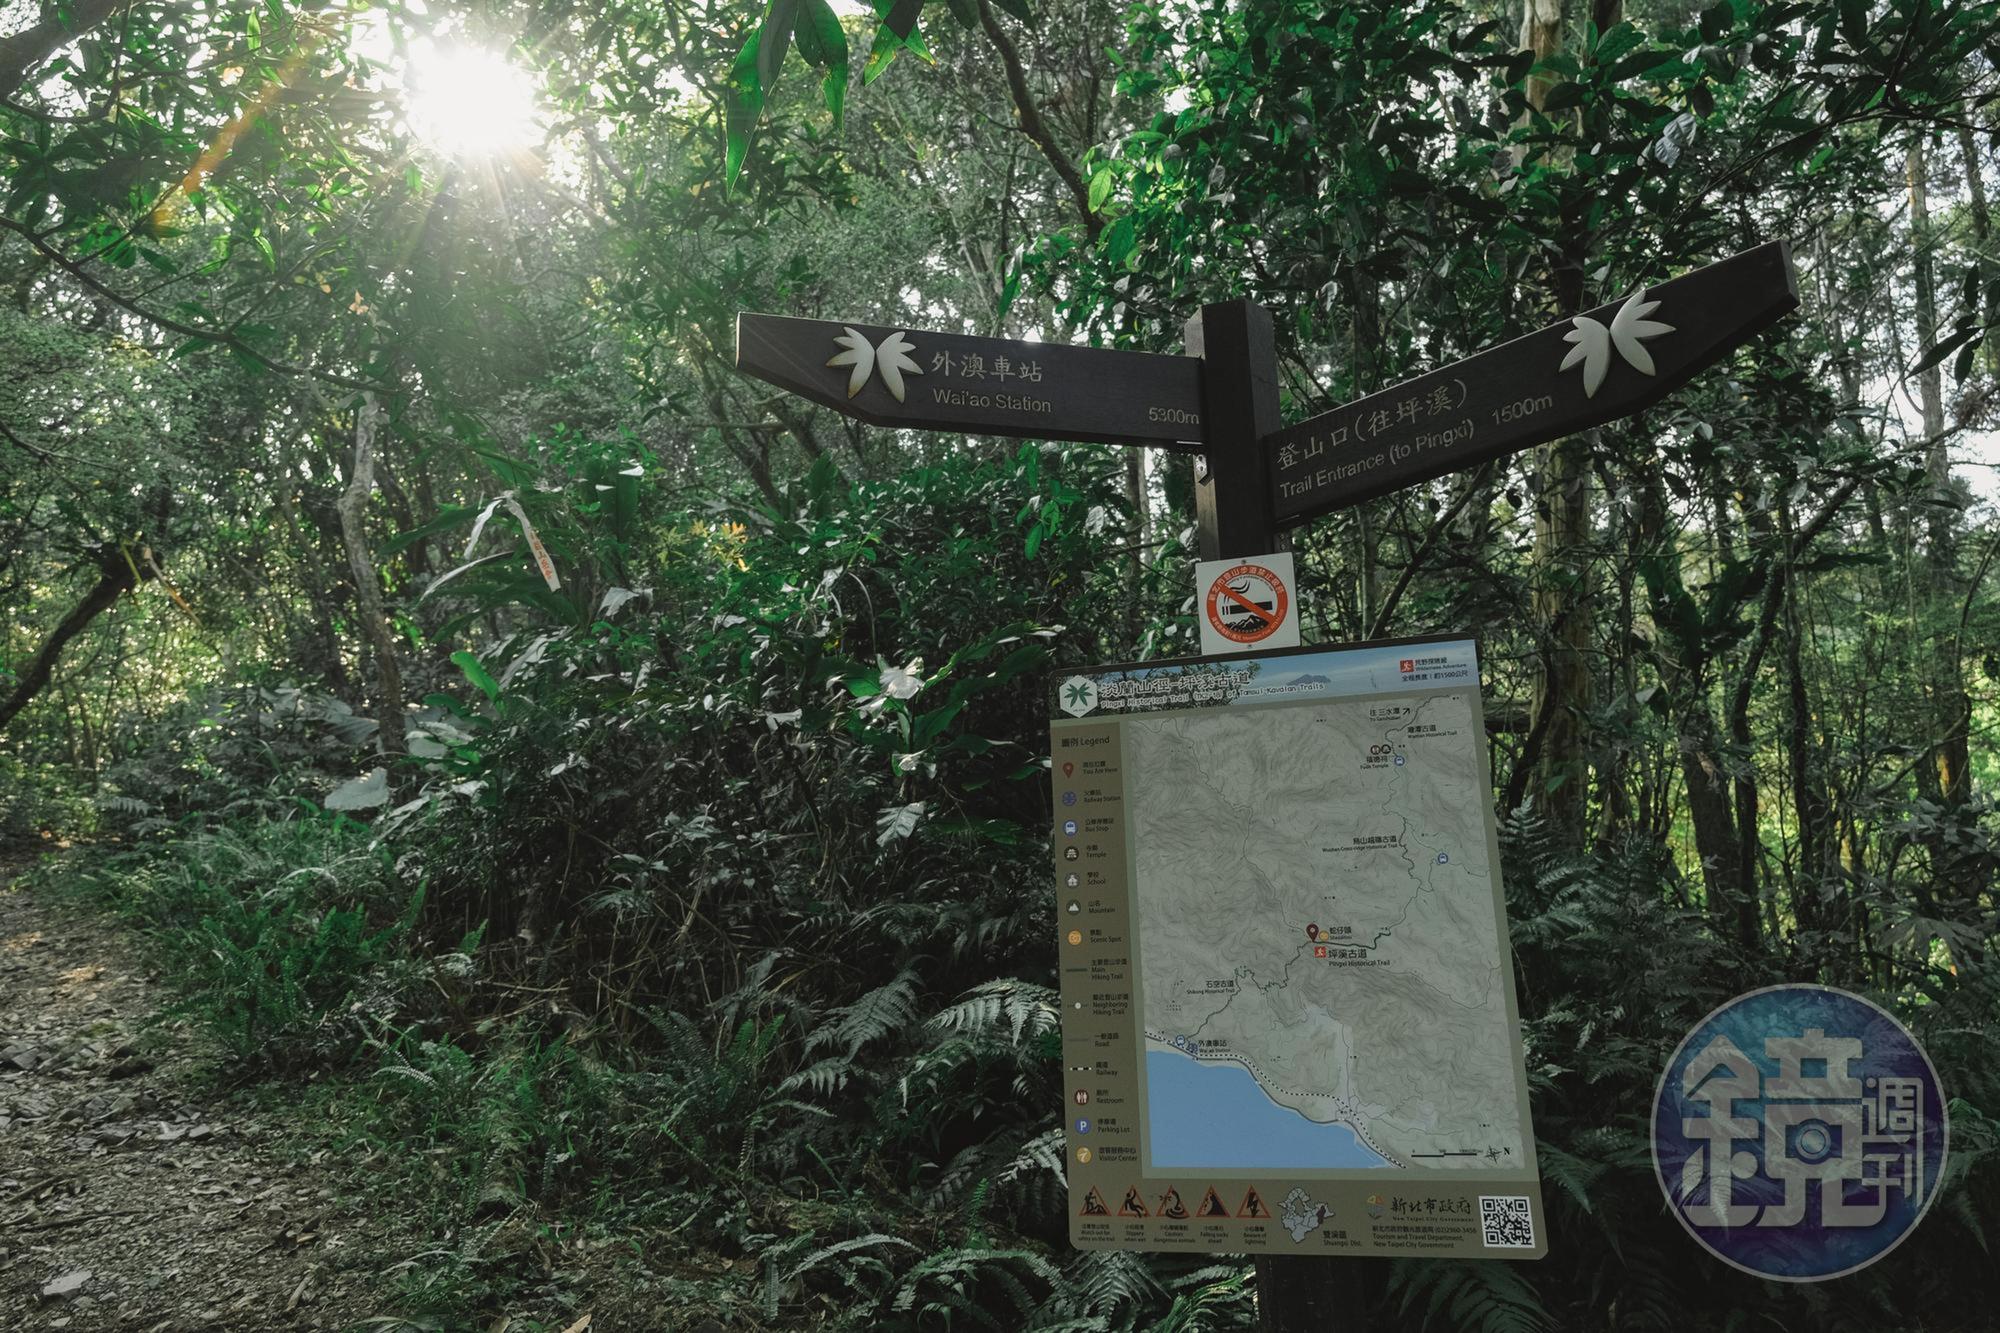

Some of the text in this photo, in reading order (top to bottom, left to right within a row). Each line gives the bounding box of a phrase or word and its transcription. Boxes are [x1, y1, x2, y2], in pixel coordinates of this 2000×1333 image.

[931, 350, 1043, 383] 外澳車站
[932, 388, 1052, 413] Wai'ao Station
[1148, 407, 1200, 425] 5300m
[1490, 394, 1553, 426] 1500m
[1276, 378, 1468, 471] 登山口(往坪溪)
[1280, 418, 1475, 498] Trail Entrance (to Pingxi)
[1127, 695, 1167, 707] Historical
[1170, 693, 1190, 703] Trail
[1227, 689, 1236, 697] of
[1080, 735, 1110, 747] Legend
[1087, 878, 1106, 886] School
[1328, 948, 1367, 959] 坪溪古道
[1348, 959, 1376, 967] Historical
[1091, 973, 1110, 981] Hiking
[1080, 1120, 1087, 1131] P
[1390, 1196, 1471, 1215] 新北市政府
